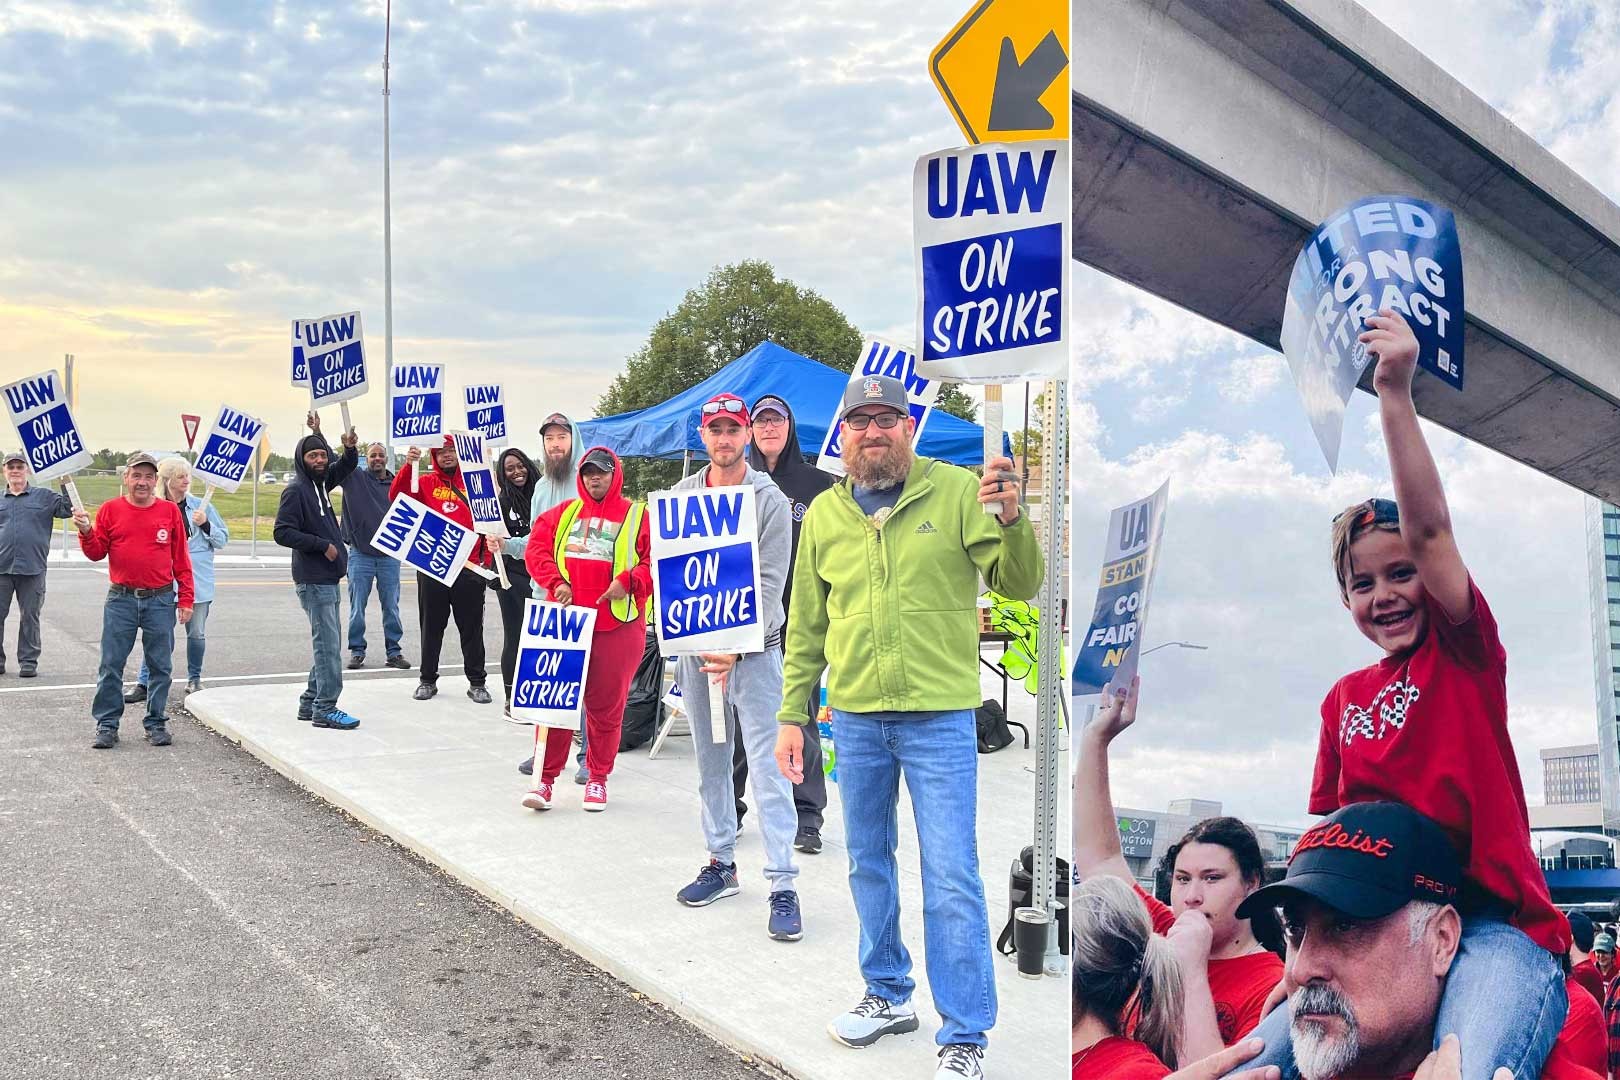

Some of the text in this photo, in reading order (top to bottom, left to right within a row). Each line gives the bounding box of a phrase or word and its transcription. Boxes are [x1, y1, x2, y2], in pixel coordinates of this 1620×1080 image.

[927, 150, 1057, 219] UAW
[1305, 202, 1437, 272] ITED
[960, 237, 1014, 292] ON
[1313, 249, 1446, 342] RONG
[305, 315, 355, 347] UAW
[929, 288, 1059, 353] STRIKE
[324, 349, 344, 372] ON
[862, 341, 930, 396] UAW
[315, 363, 363, 396] STRIKE
[395, 366, 440, 389] UAW
[4, 374, 56, 414] UAW
[405, 396, 426, 415] ON
[466, 385, 500, 405] UAW
[33, 413, 53, 441] ON
[218, 408, 262, 441] UAW
[394, 414, 441, 436] STRIKE
[477, 409, 492, 425] ON
[32, 429, 79, 468] STRIKE
[217, 439, 237, 458] ON
[454, 433, 484, 464] UAW
[200, 453, 245, 480] STRIKE
[470, 474, 484, 495] ON
[471, 495, 500, 521] STRIKE
[658, 492, 744, 541] UAW
[376, 498, 420, 552] UAW
[1119, 503, 1149, 551] UA
[414, 529, 435, 555] ON
[429, 522, 463, 576] STRIKE
[684, 551, 720, 591] ON
[527, 604, 588, 643] UAW
[666, 585, 754, 633] STRIKE
[1088, 622, 1137, 647] FAIR
[535, 650, 562, 677] ON
[517, 680, 580, 709] STRIKE
[1121, 835, 1153, 845] NGTON
[1415, 874, 1444, 893] PRO
